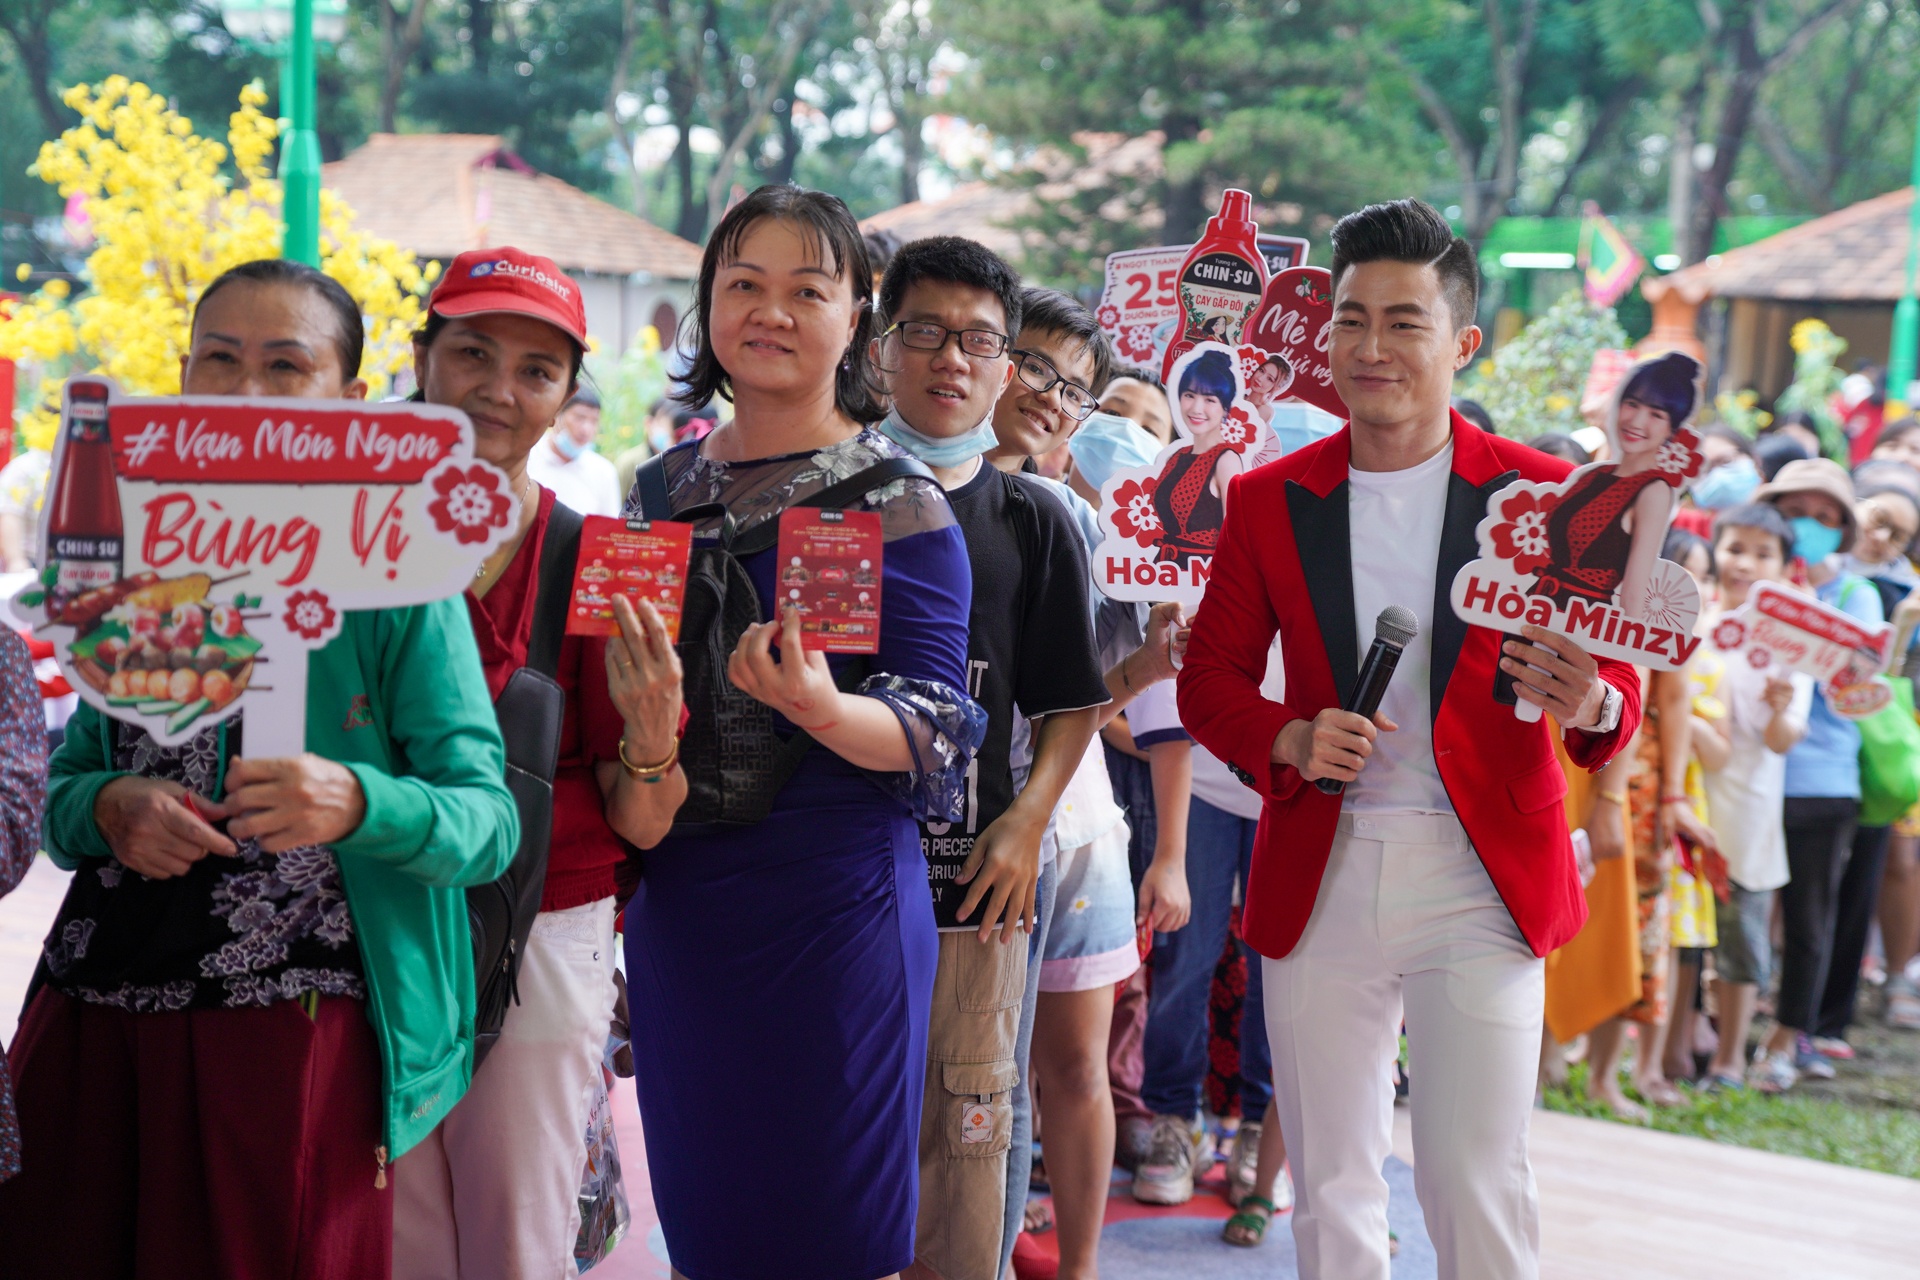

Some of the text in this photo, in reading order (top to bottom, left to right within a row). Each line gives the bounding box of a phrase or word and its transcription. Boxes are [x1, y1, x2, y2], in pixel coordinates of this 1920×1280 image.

[1193, 262, 1254, 286] CHIN-SU
[1195, 294, 1244, 312] CAY GẤP ĐÔI
[1258, 303, 1307, 345] Mê
[252, 418, 336, 461] Món
[345, 418, 440, 472] Ngon
[140, 486, 411, 587] Bùng Vị
[1106, 556, 1178, 586] Hòa
[1462, 576, 1702, 666] Hòa Minzy
[931, 837, 975, 856] PIECES
